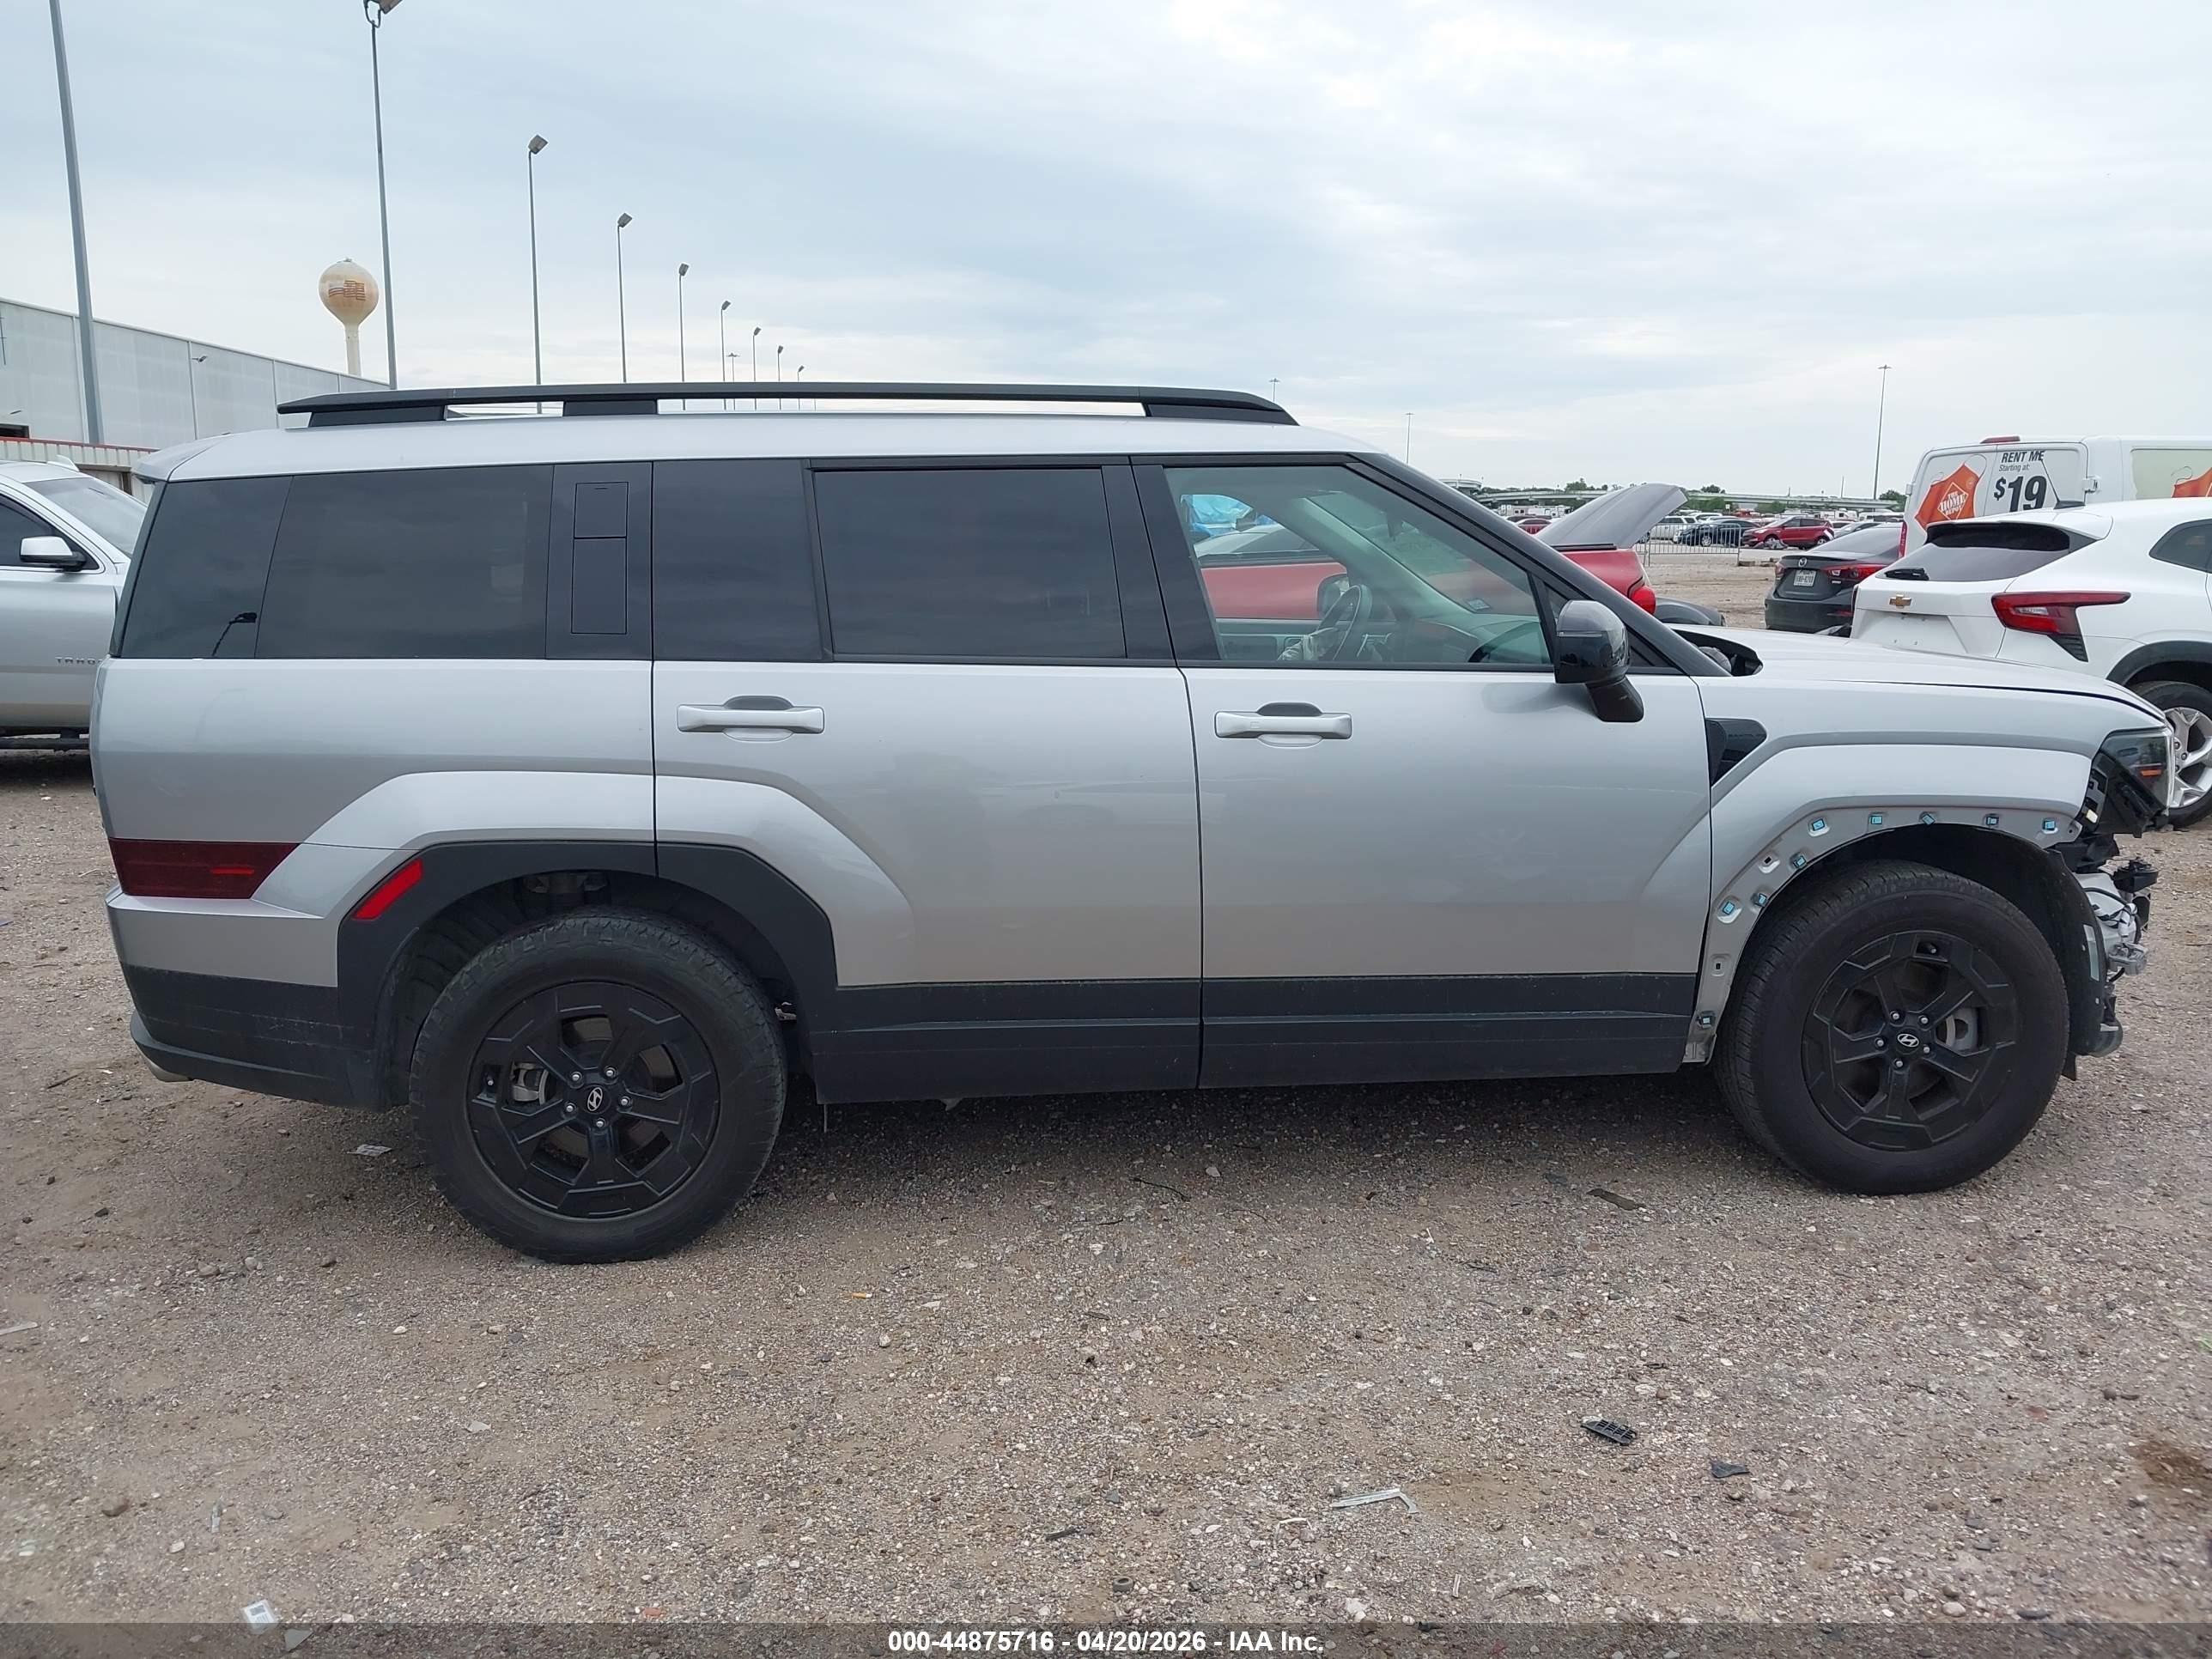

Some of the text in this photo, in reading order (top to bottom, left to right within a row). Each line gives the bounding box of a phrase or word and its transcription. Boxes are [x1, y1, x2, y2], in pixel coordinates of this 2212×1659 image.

[2002, 450, 2045, 463] RENT ME
[1999, 464, 2021, 472] Starting
[1994, 475, 2047, 513] $19
[1940, 493, 1966, 512] HOME
[1945, 505, 1960, 516] DEPOT
